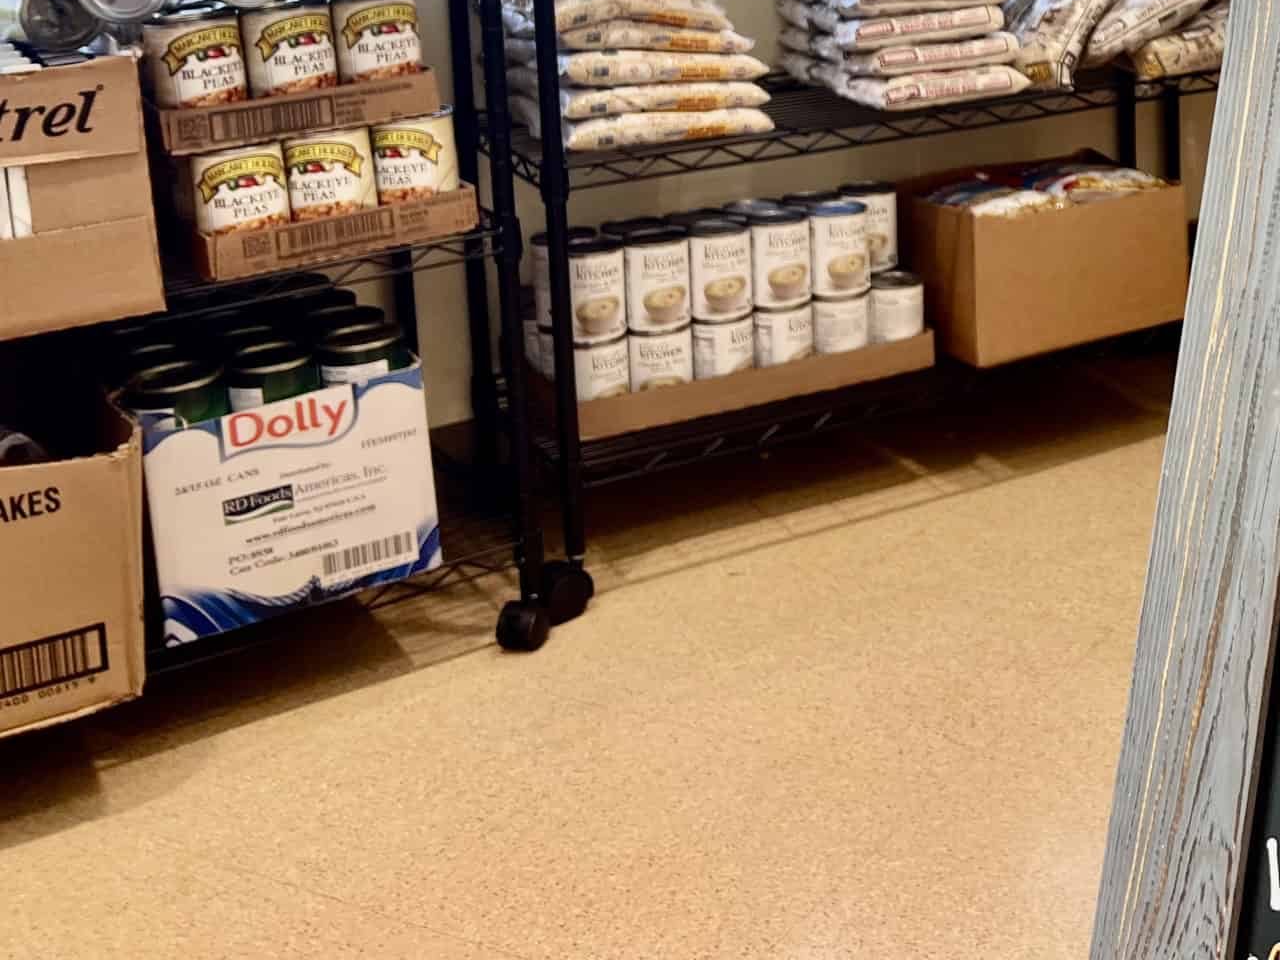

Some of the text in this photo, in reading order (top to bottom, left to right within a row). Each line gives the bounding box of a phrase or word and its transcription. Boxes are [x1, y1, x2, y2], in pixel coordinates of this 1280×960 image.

[228, 397, 348, 448] Dolly
[223, 498, 249, 515] RD
[251, 488, 292, 509] Foods
